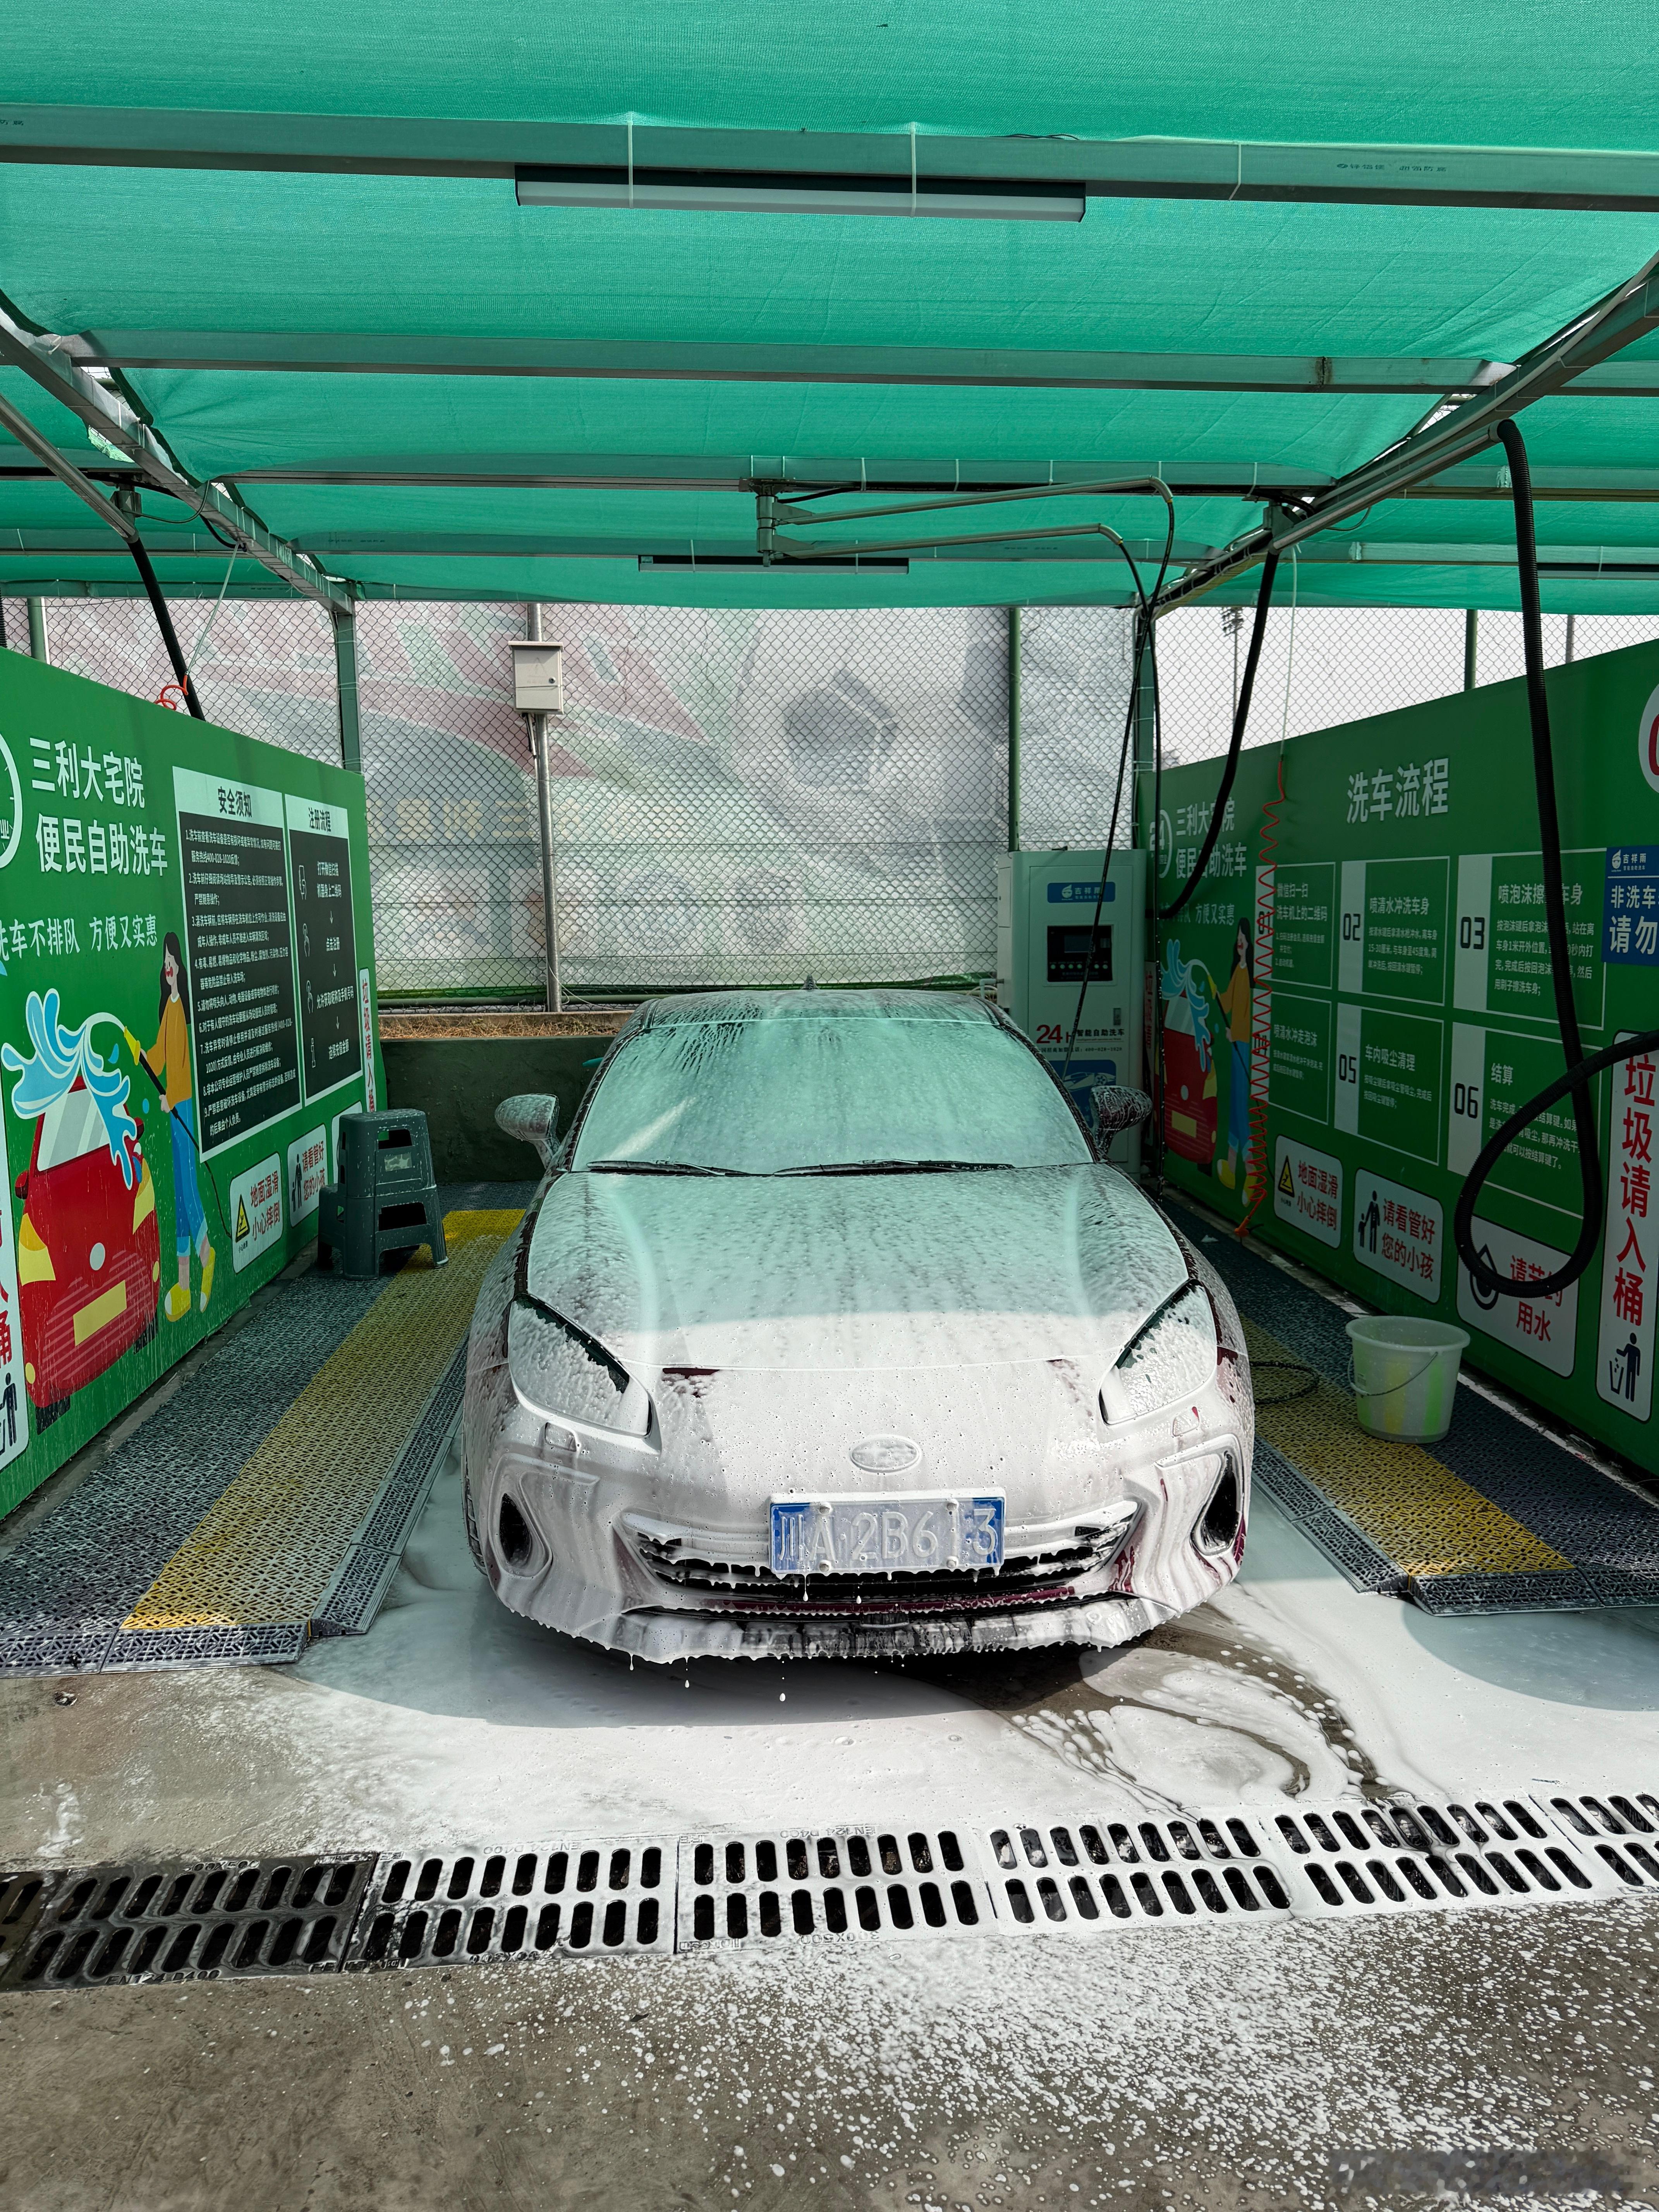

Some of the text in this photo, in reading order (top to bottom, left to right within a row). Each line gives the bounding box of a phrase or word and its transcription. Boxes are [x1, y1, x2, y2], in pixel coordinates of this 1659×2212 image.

[29, 737, 145, 808] 三利大宅院
[218, 786, 252, 817] 安全须知
[1347, 758, 1449, 824] 洗车流程
[308, 807, 331, 832] 注册流程
[1176, 797, 1235, 836] 三利大院
[36, 813, 168, 876] 便民自助洗车
[1176, 842, 1247, 879] 便民助洗车
[1623, 853, 1647, 864] 吉祥雨
[1277, 883, 1308, 898] 微信扫一扫
[1369, 896, 1429, 915] 喷清水冲洗车身
[1498, 883, 1583, 905] 喷泡沫擦车身
[1610, 885, 1659, 909] 非洗车
[1195, 903, 1235, 926] 方便又实惠
[1276, 905, 1328, 921] 洗车机上的二维码
[1343, 913, 1361, 941] 02
[89, 914, 157, 952] 方便又实惠
[1460, 916, 1485, 950] 03
[1609, 915, 1658, 955] 请勿
[1077, 1029, 1125, 1037] 智能自助洗车
[1273, 1024, 1317, 1047] 喷清水冲走泡沫
[1339, 1054, 1357, 1084] 05
[1365, 1043, 1415, 1072] 车内吸尘清理
[1491, 1062, 1513, 1086] 结算
[1454, 1082, 1479, 1119] 06
[302, 1140, 325, 1173] 请看管好
[250, 1170, 279, 1208] 地面湿滑
[303, 1167, 326, 1201] 您的小孩
[1298, 1160, 1338, 1199] 地面湿滑
[1613, 1054, 1657, 1326] 垃圾请入桶
[252, 1200, 281, 1241] 小心摔倒
[1297, 1192, 1337, 1231] 小心摔倒
[1383, 1198, 1435, 1245] 请看管好
[1381, 1233, 1434, 1282] 您的小孩
[1516, 1301, 1551, 1342] 用水
[171, 1969, 222, 1981] D400
